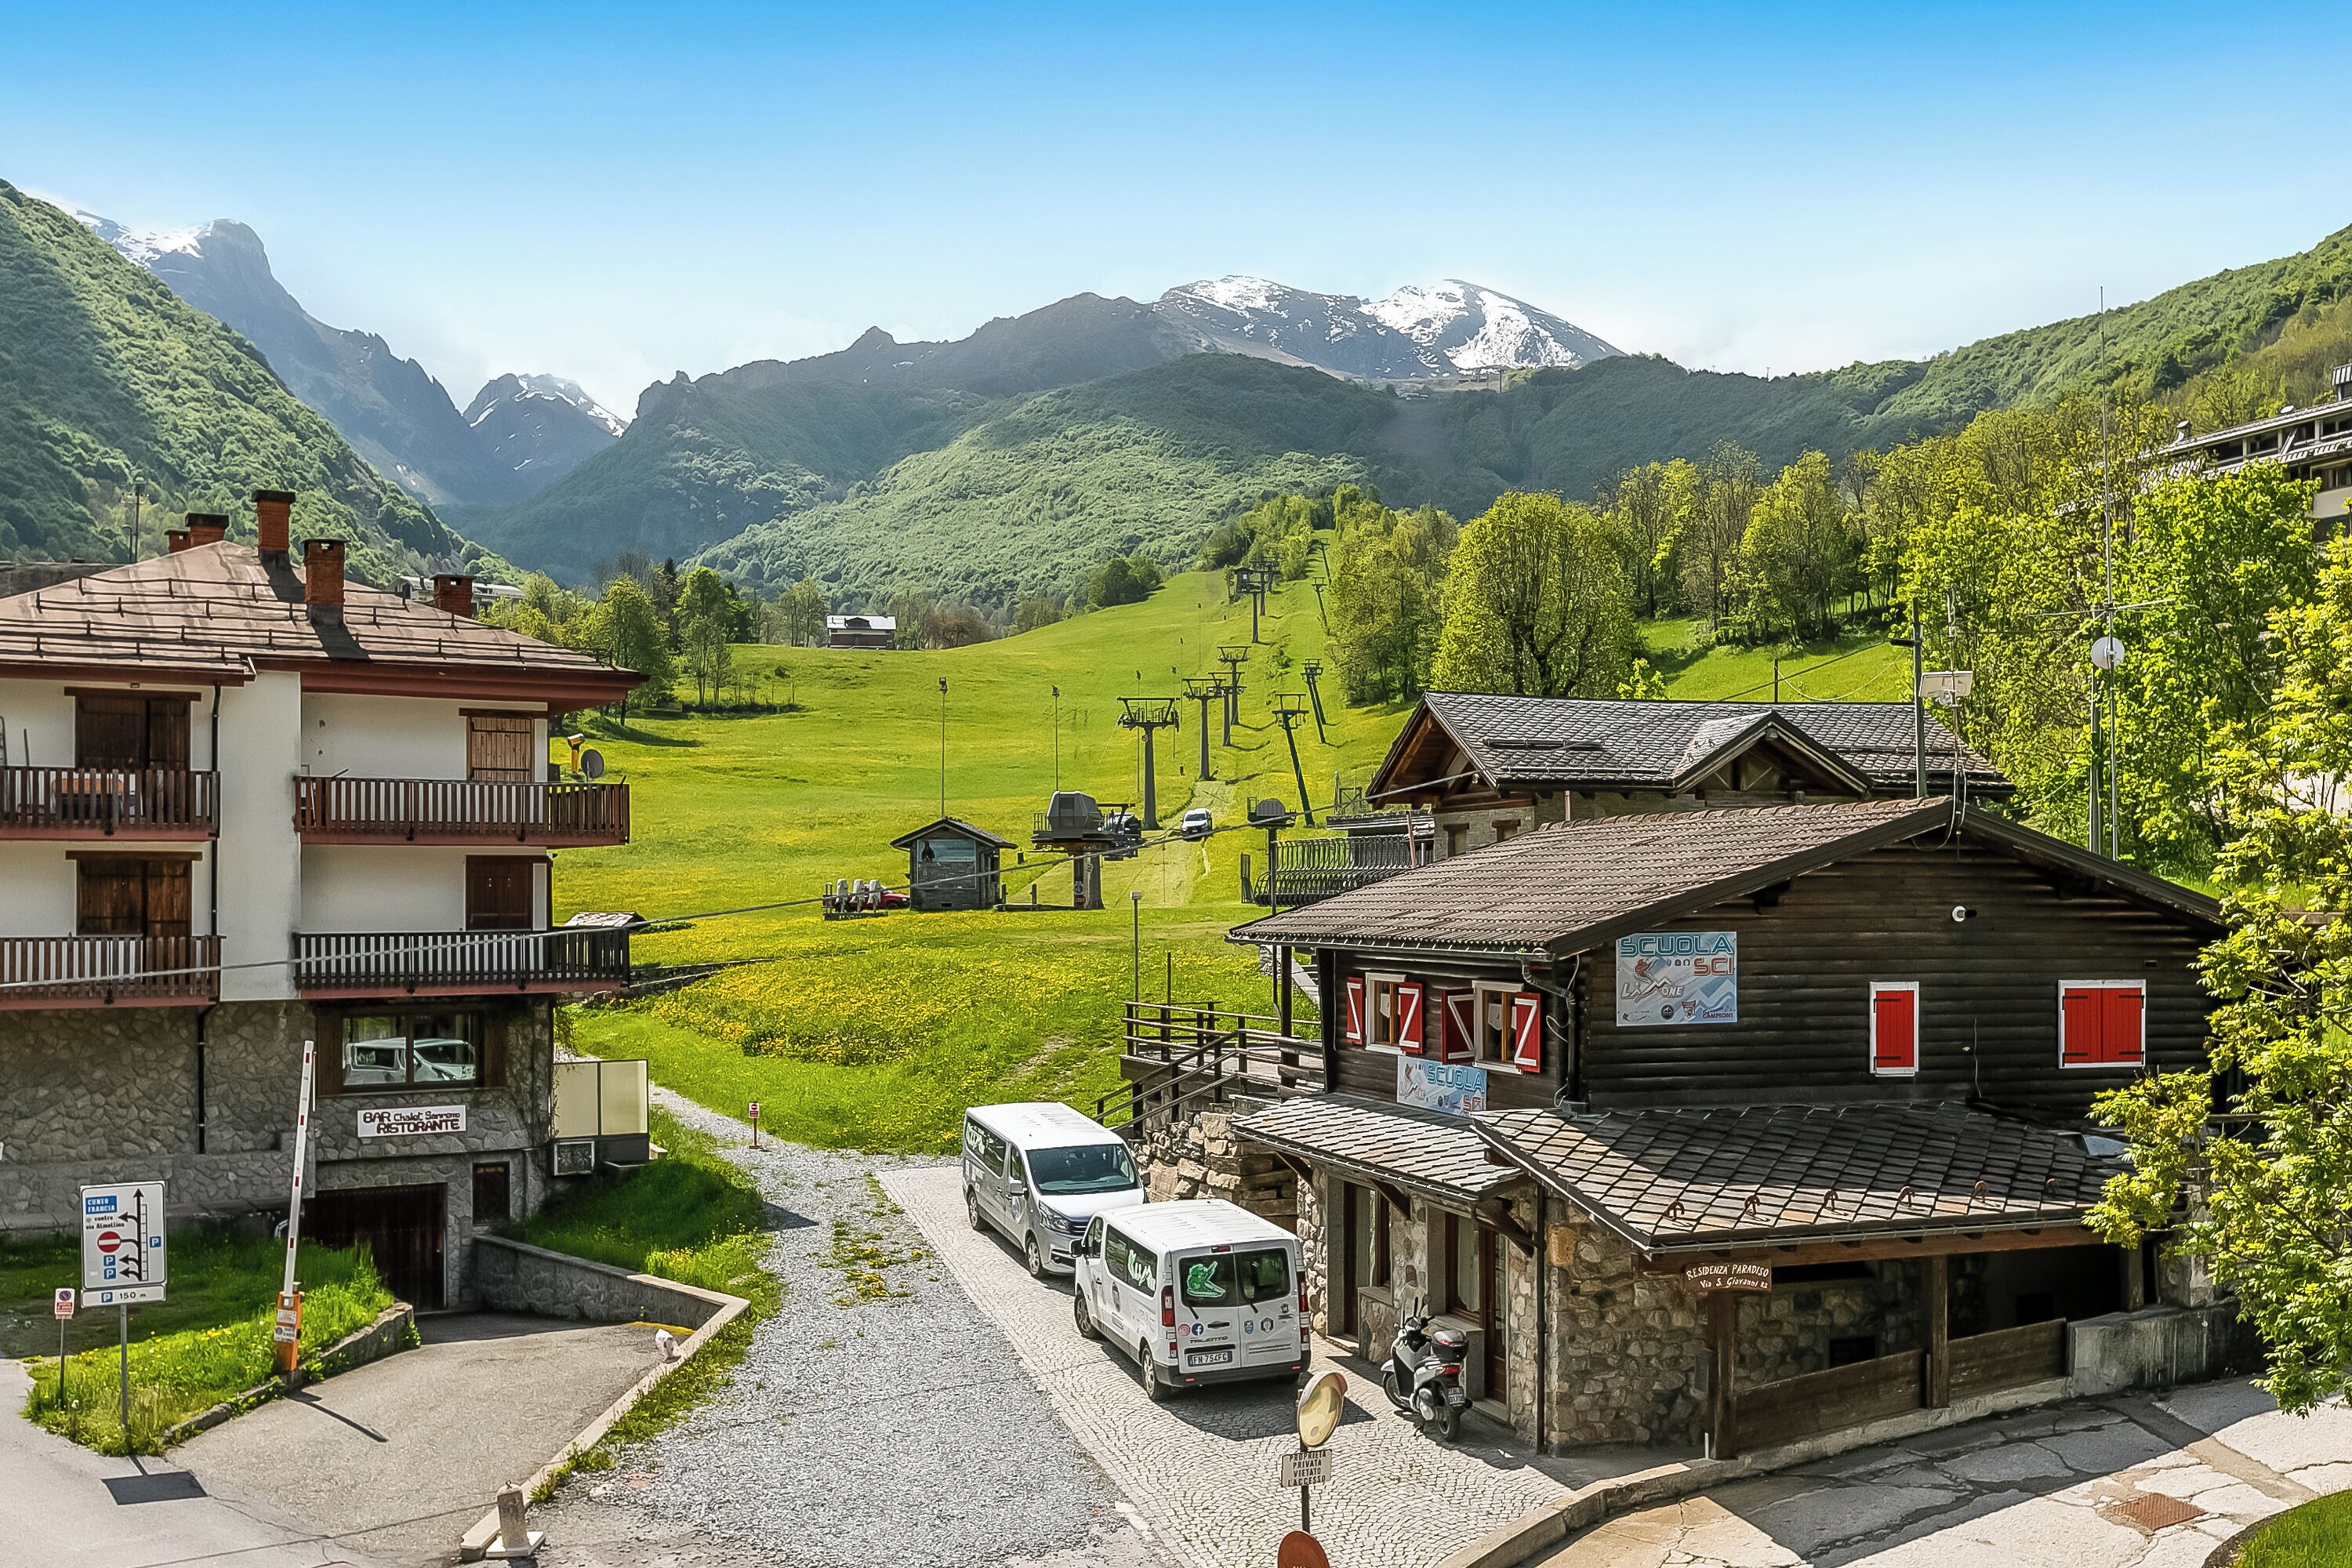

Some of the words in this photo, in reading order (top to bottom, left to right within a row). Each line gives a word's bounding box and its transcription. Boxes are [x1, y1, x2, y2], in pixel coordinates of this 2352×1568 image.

[1620, 935, 1734, 956] SCUOLA
[1693, 956, 1734, 976] SCI
[1427, 1064, 1485, 1094] SCUOLA
[1463, 1094, 1484, 1112] SCI
[363, 1112, 391, 1123] BAR
[394, 1112, 423, 1121] Chalet
[376, 1119, 460, 1134] RISTORANTE
[1732, 1265, 1769, 1277] PARADISO
[1700, 1279, 1711, 1288] Via
[1727, 1277, 1758, 1287] Giovanni
[1193, 1356, 1203, 1365] FN
[1293, 1459, 1322, 1469] PRIVATA
[1293, 1468, 1321, 1477] VIETATO
